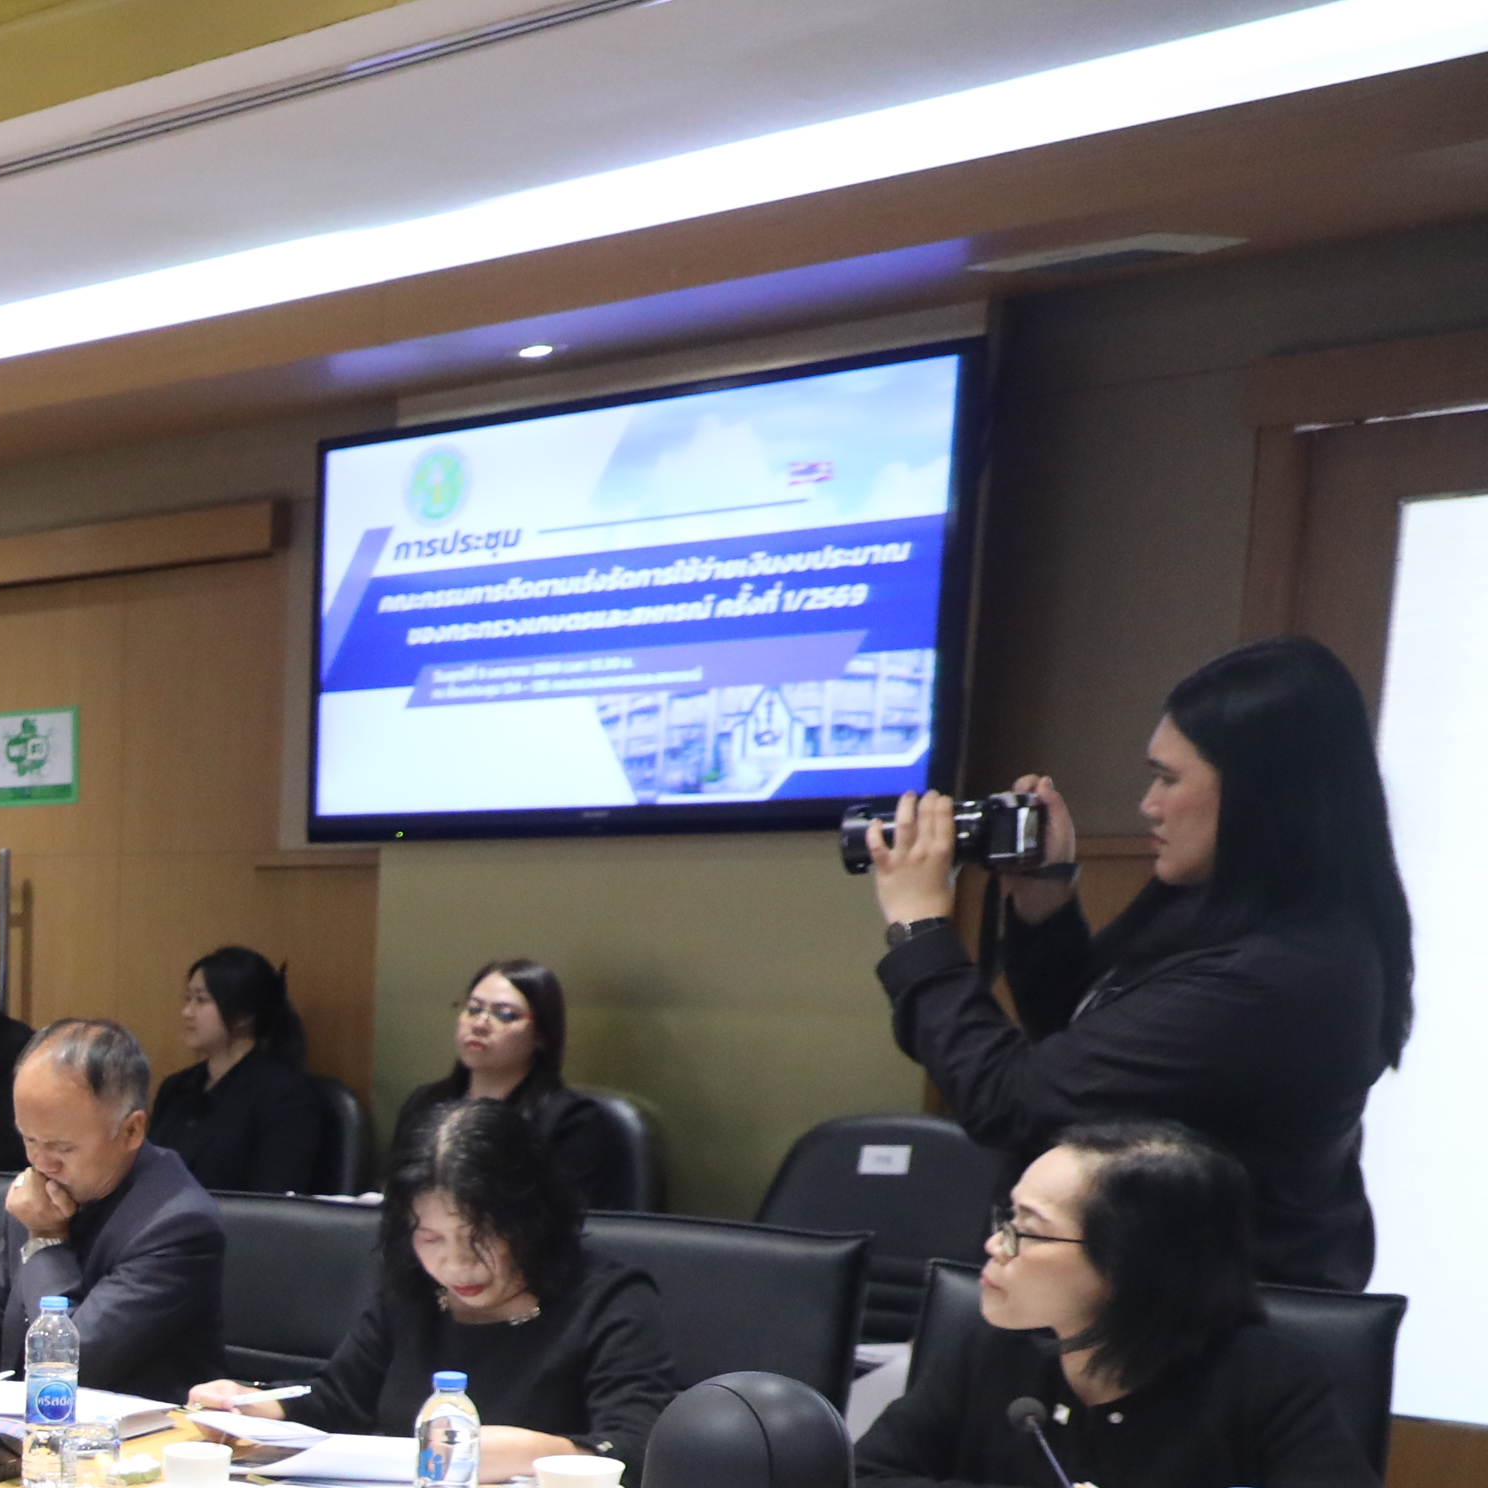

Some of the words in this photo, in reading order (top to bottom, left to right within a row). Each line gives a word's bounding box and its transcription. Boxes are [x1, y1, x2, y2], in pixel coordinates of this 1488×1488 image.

[393, 528, 522, 559] การประชุม
[781, 583, 870, 613] 1/2569
